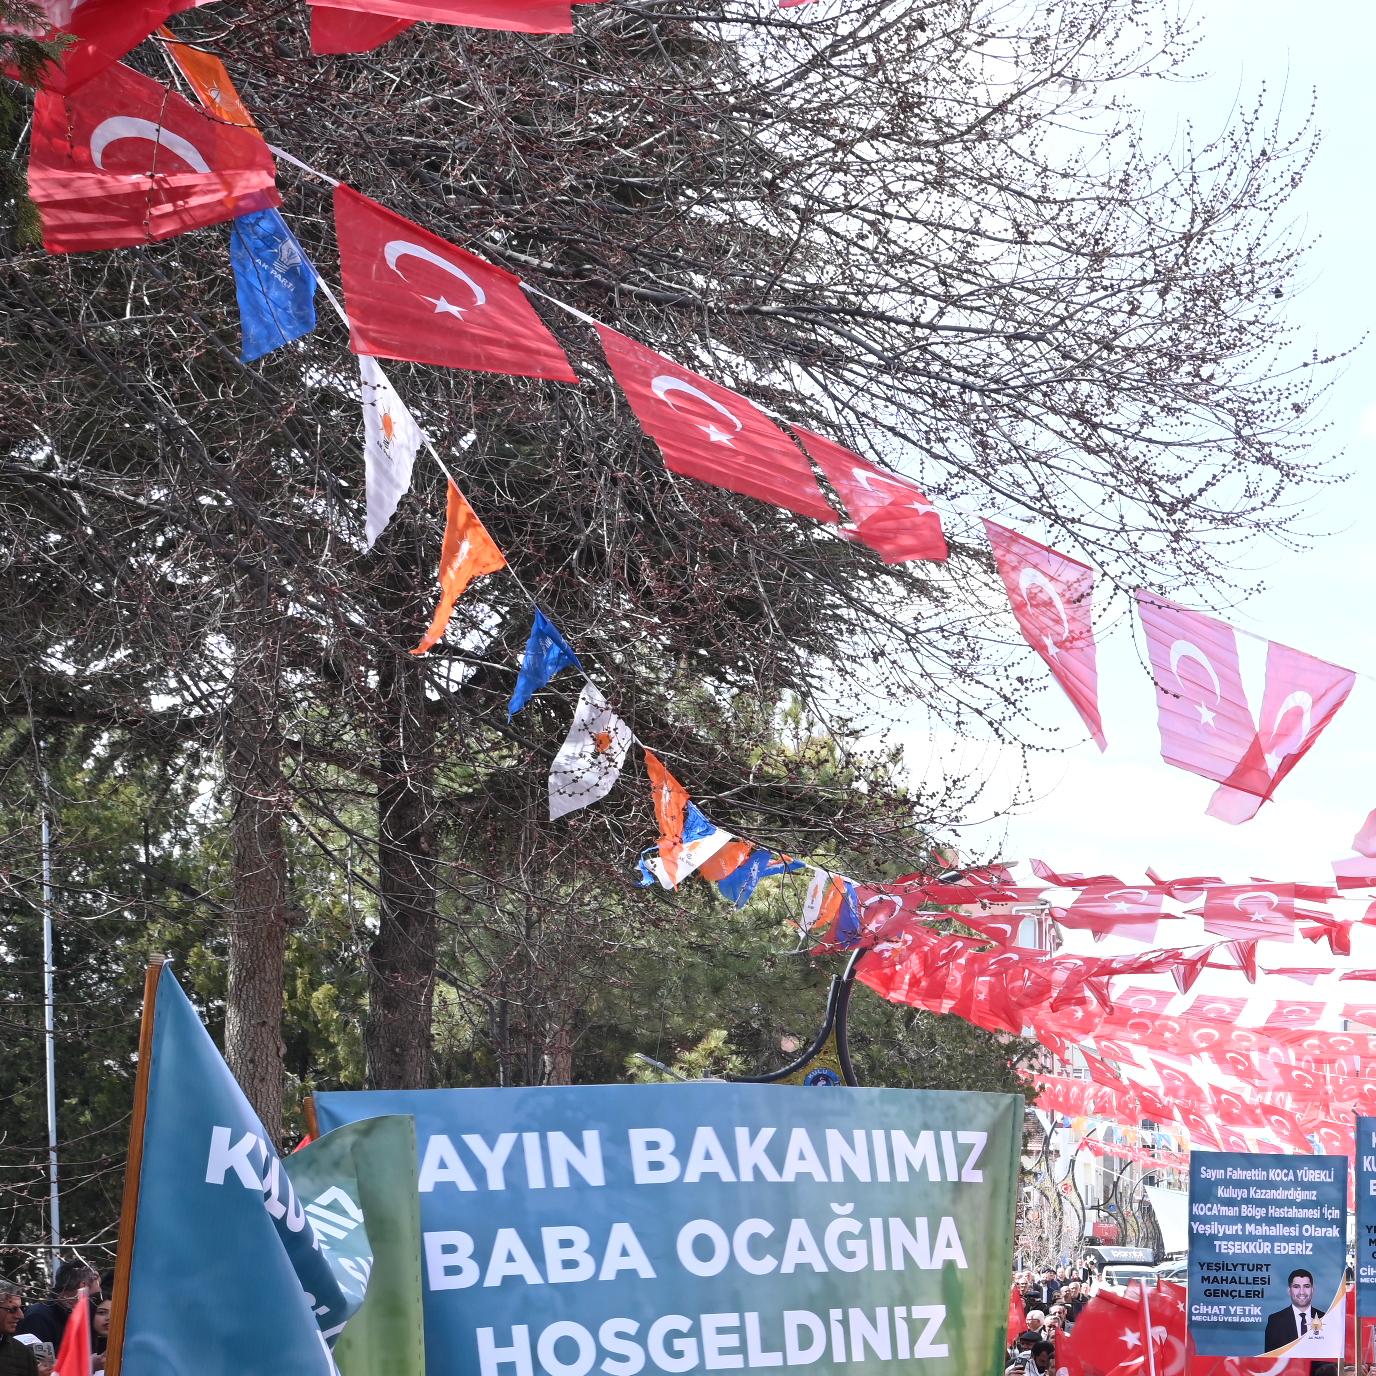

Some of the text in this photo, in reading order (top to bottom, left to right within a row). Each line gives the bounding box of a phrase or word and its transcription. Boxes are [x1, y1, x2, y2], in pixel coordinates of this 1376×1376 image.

[418, 1126, 988, 1192] AYIN BAKANIMIZ
[1201, 1167, 1334, 1182] Sayın Fahrettin KOCA YÜREKLİ
[1218, 1186, 1316, 1202] Kuluya Kazandırdığınız
[1241, 1204, 1266, 1219] Bölge
[1269, 1205, 1320, 1219] Hastahanesi
[1191, 1222, 1339, 1237] Yeşilyurt Mahallesi Olarak
[424, 1222, 656, 1292] BABA
[676, 1202, 968, 1277] OCAĞINA
[1214, 1239, 1312, 1255] TEŞEKKÜR EDERİZ
[1198, 1261, 1271, 1273] YEŞİLYTURT
[1201, 1274, 1271, 1286] MAHALLESİ
[1204, 1288, 1264, 1299] GENÇLERİ
[1192, 1304, 1261, 1315] CİHAT YETİK
